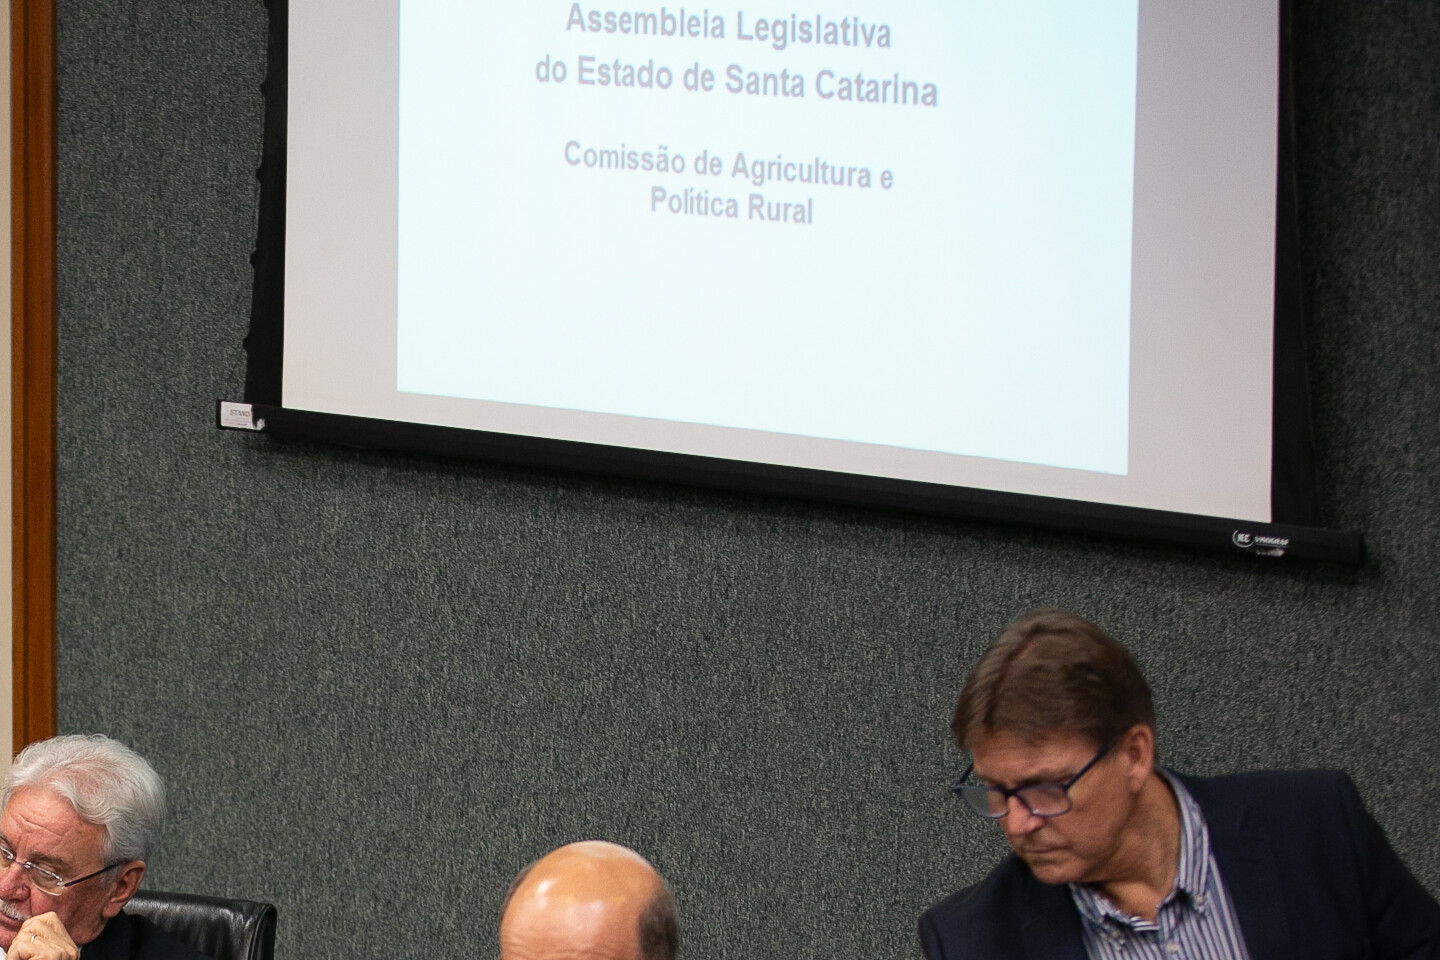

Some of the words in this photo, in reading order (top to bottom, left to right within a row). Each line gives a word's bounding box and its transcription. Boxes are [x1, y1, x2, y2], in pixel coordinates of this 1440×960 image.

[566, 2, 725, 39] Assembleia
[736, 11, 891, 50] Legislativa
[535, 54, 567, 84] do
[577, 55, 673, 91] Estado
[683, 62, 715, 92] de
[725, 64, 805, 98] Santa
[815, 69, 938, 107] Catarina
[564, 140, 686, 174] Comissão
[694, 149, 722, 176] de
[731, 151, 871, 188] Agricultura
[880, 168, 893, 190] e
[651, 186, 739, 219] Política
[748, 193, 813, 225] Rural
